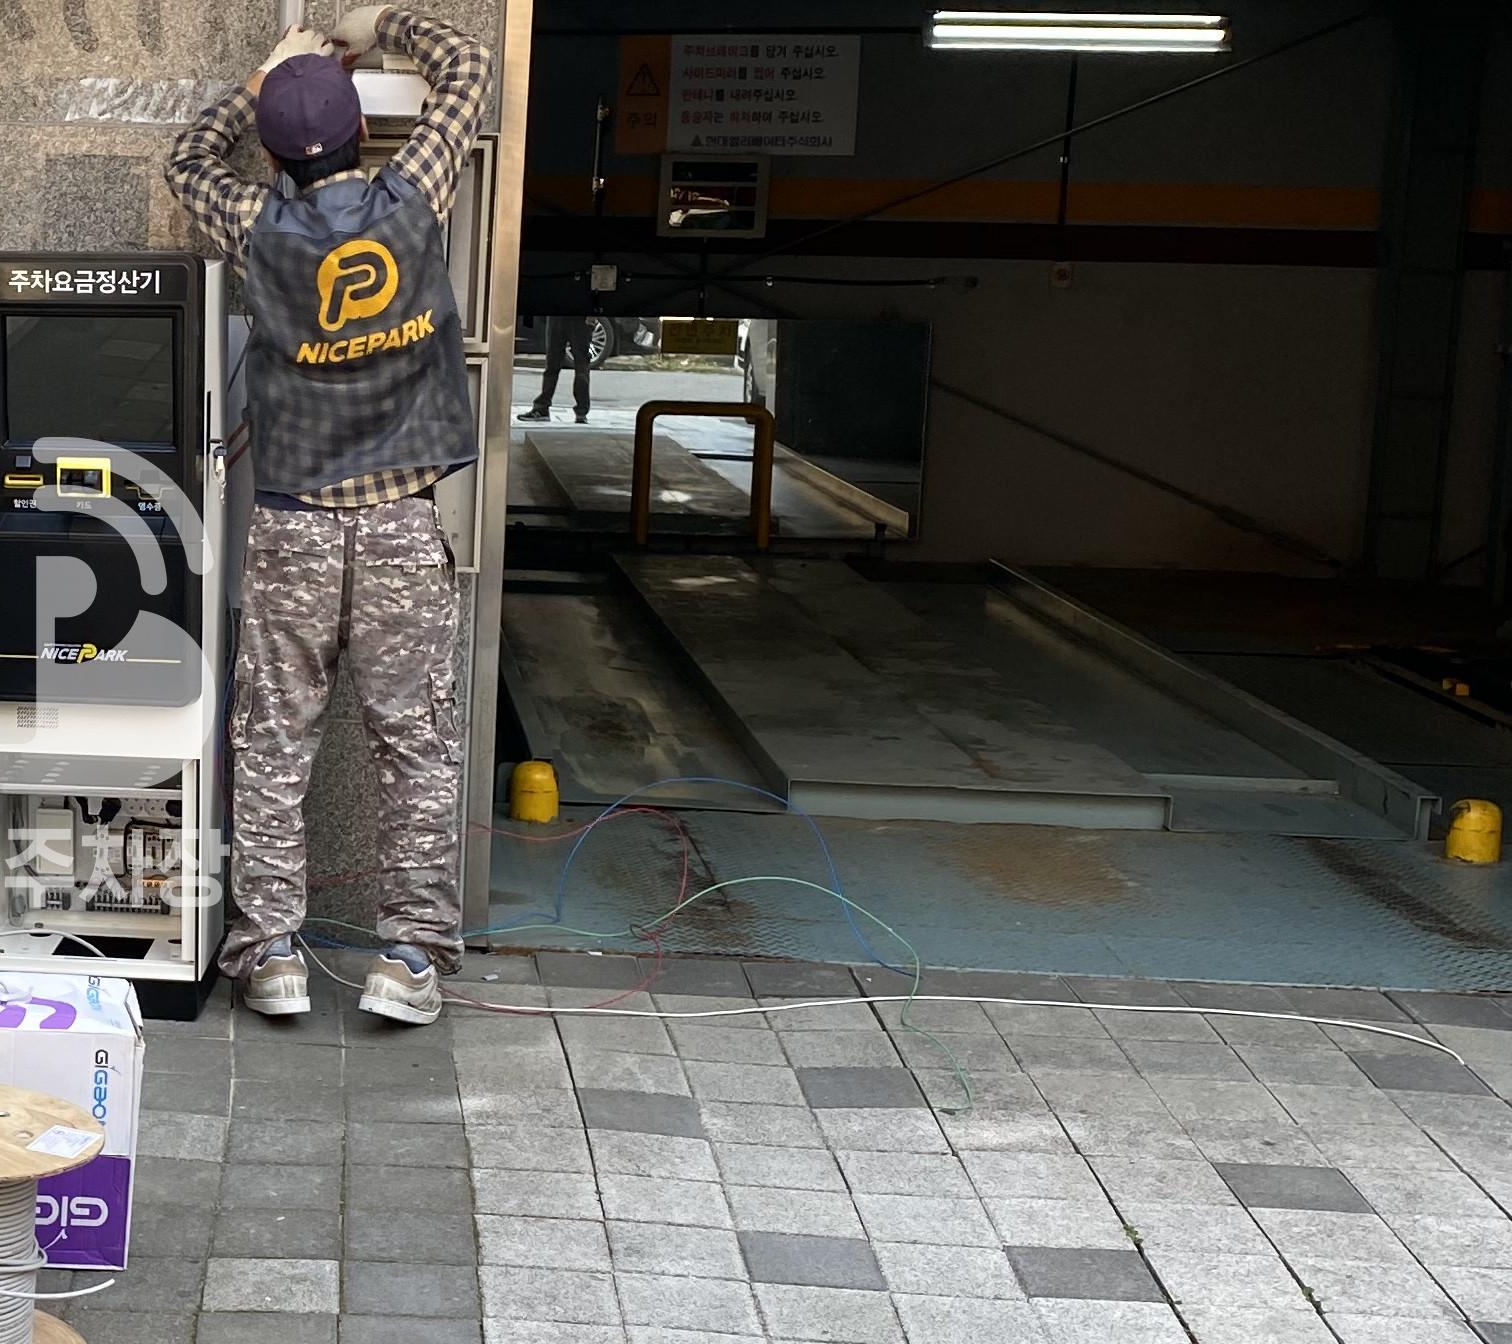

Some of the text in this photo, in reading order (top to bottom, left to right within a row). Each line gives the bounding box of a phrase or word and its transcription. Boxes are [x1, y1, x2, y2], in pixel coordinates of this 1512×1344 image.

[7, 268, 162, 296] 주차요금정산기
[296, 309, 435, 366] NICEPARK
[40, 642, 128, 664] NICEPARK
